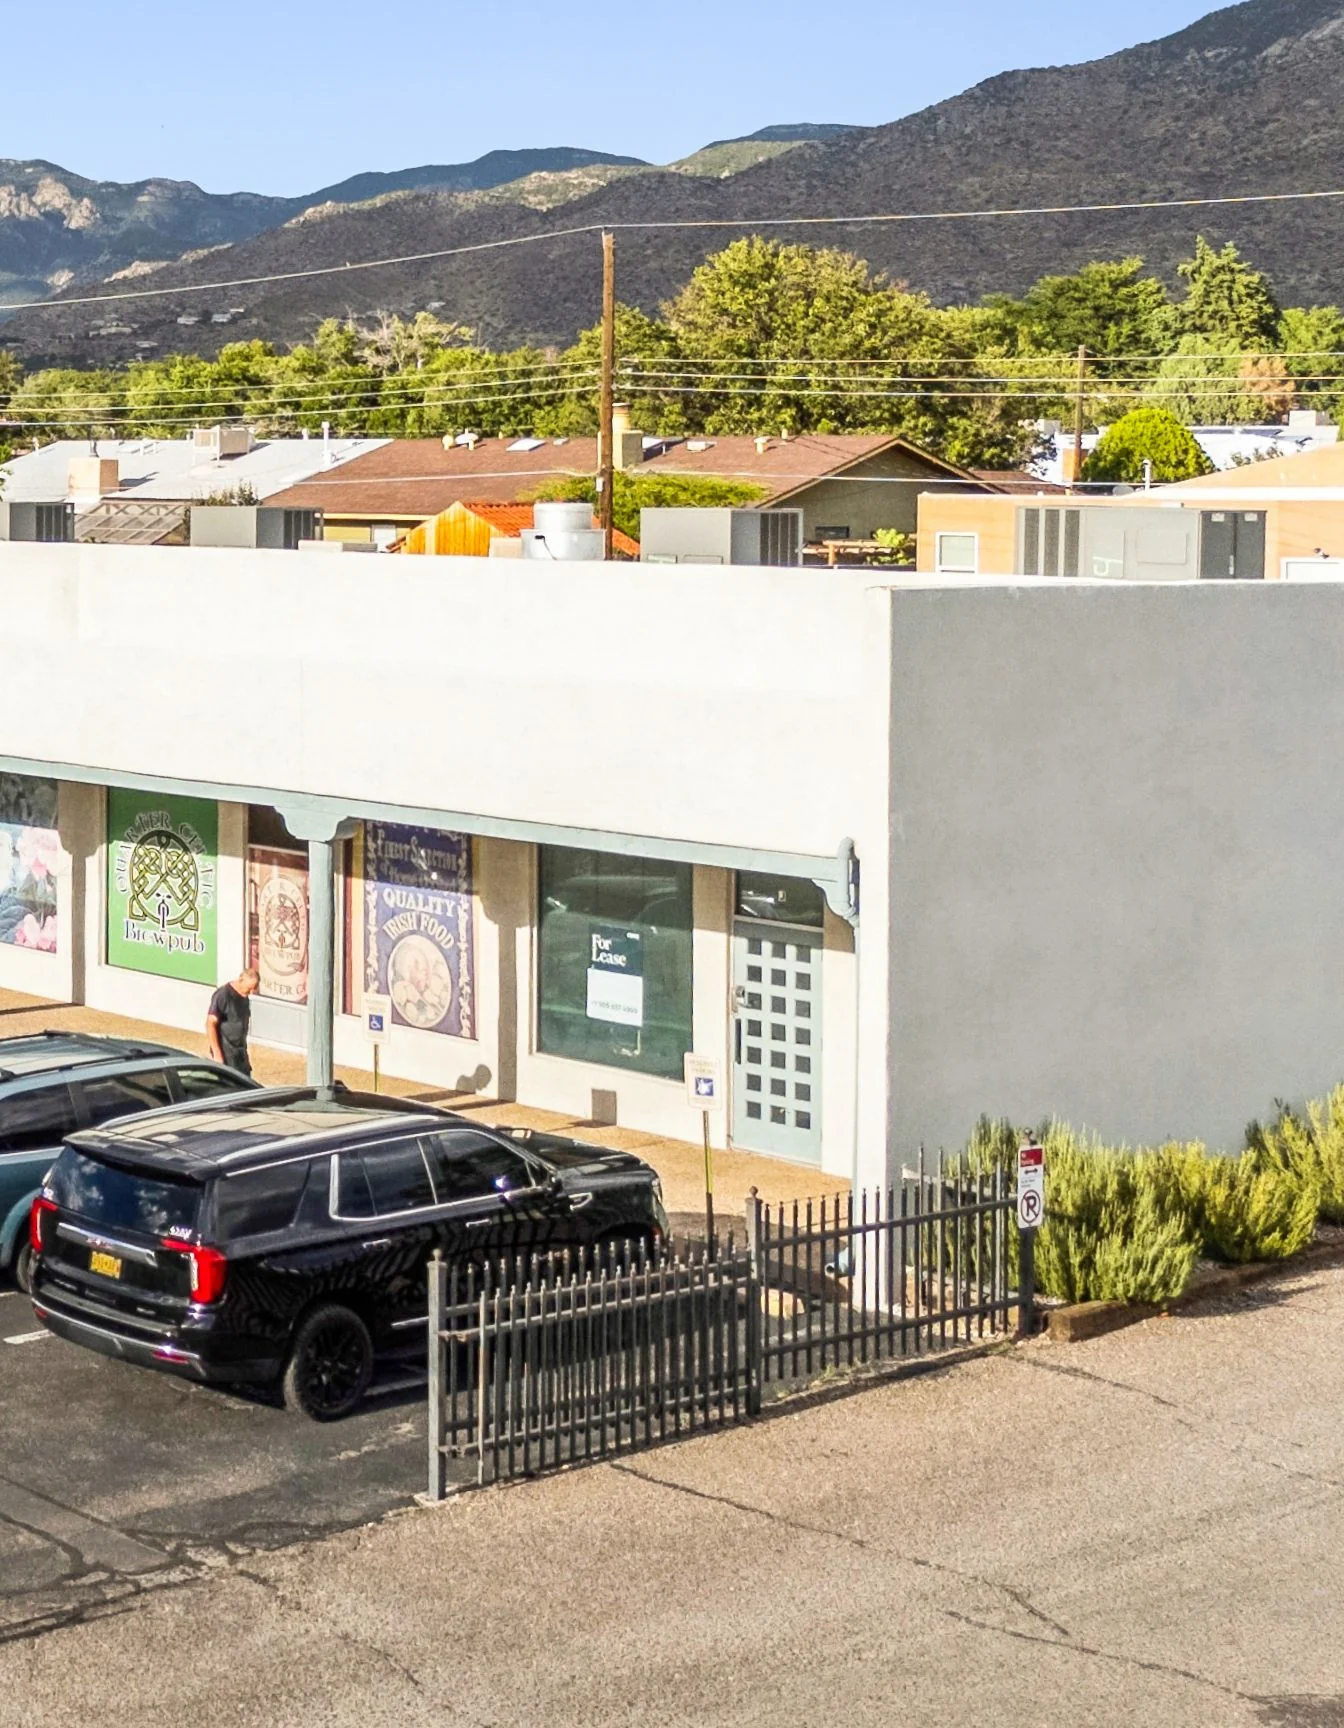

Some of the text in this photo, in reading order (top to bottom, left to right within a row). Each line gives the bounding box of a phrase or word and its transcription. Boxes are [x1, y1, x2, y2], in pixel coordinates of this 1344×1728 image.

[115, 811, 173, 893] QUARTER
[383, 888, 456, 917] QUALITY
[124, 920, 205, 952] Brewpub
[382, 911, 455, 949] IRISH FOOD
[591, 933, 612, 950] For
[591, 946, 627, 968] Lease
